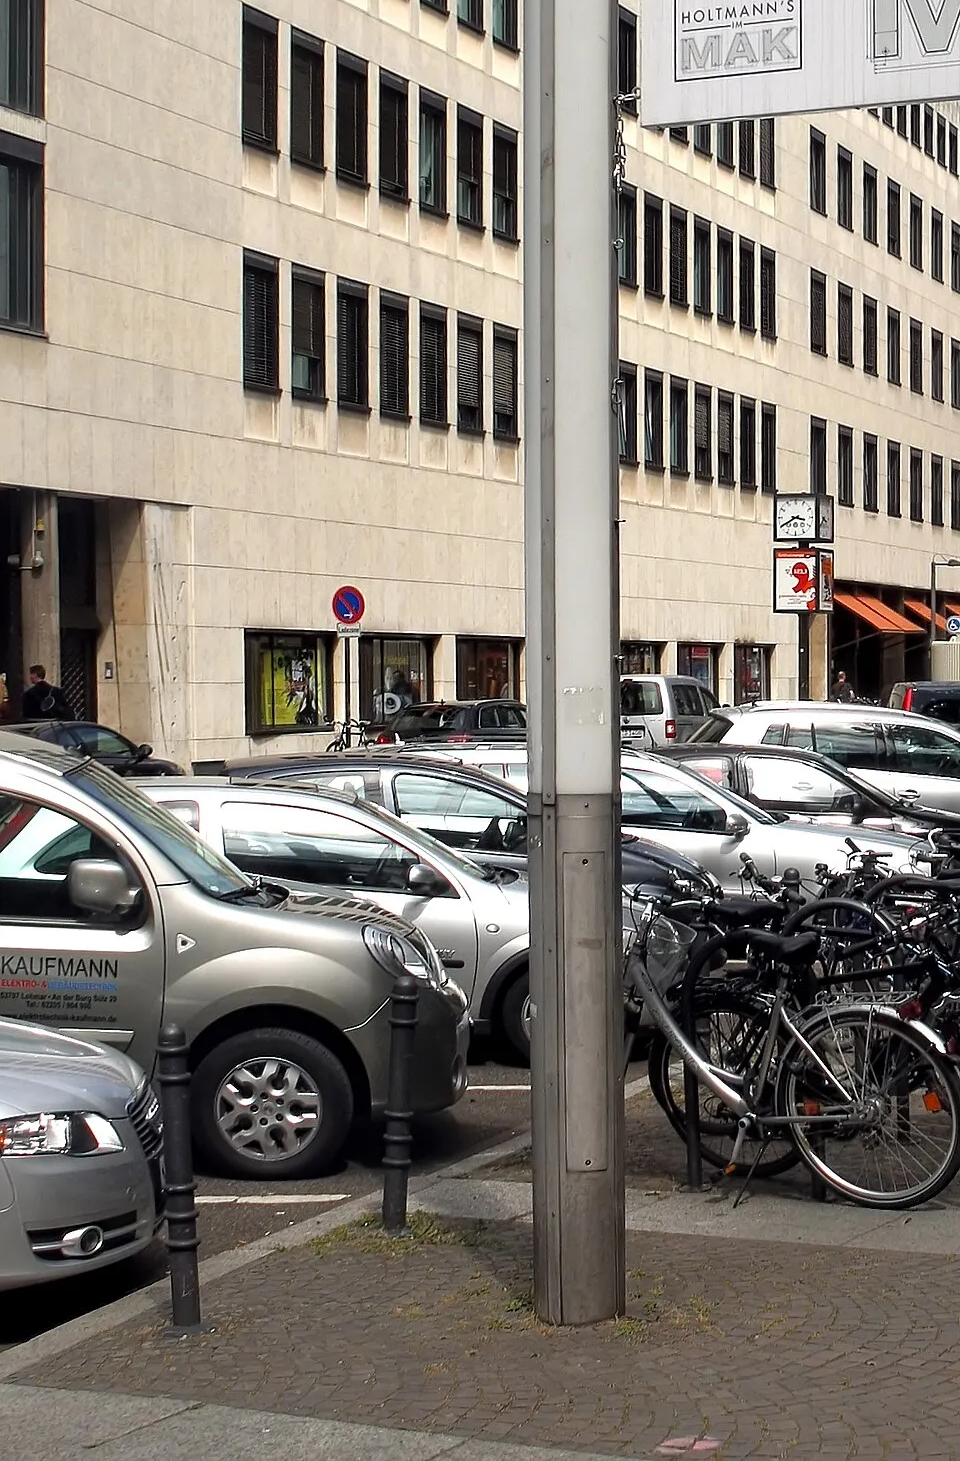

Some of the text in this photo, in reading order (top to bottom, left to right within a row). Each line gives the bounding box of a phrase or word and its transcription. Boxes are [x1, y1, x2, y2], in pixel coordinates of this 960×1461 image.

[681, 0, 795, 25] HOLTMANN'S
[731, 21, 744, 29] IM
[680, 26, 799, 71] MAK
[1, 955, 119, 979] KAUFMANN
